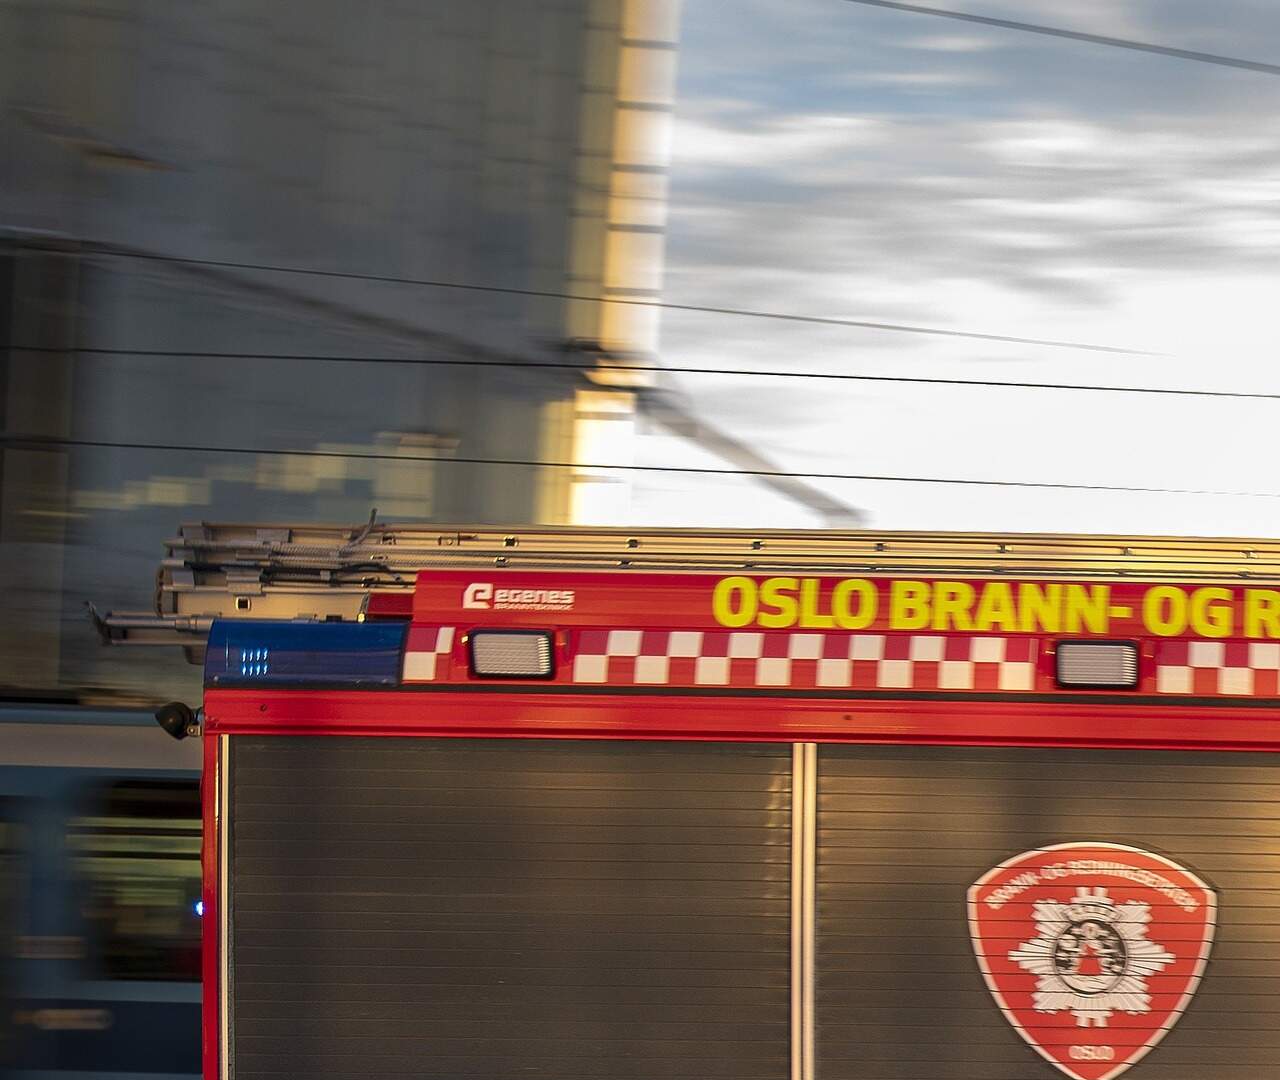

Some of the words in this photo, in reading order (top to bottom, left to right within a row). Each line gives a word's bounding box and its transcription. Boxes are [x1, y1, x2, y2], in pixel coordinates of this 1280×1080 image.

[712, 576, 879, 630] OSLO
[889, 579, 1132, 635] BRANN-
[1142, 585, 1234, 638] OG
